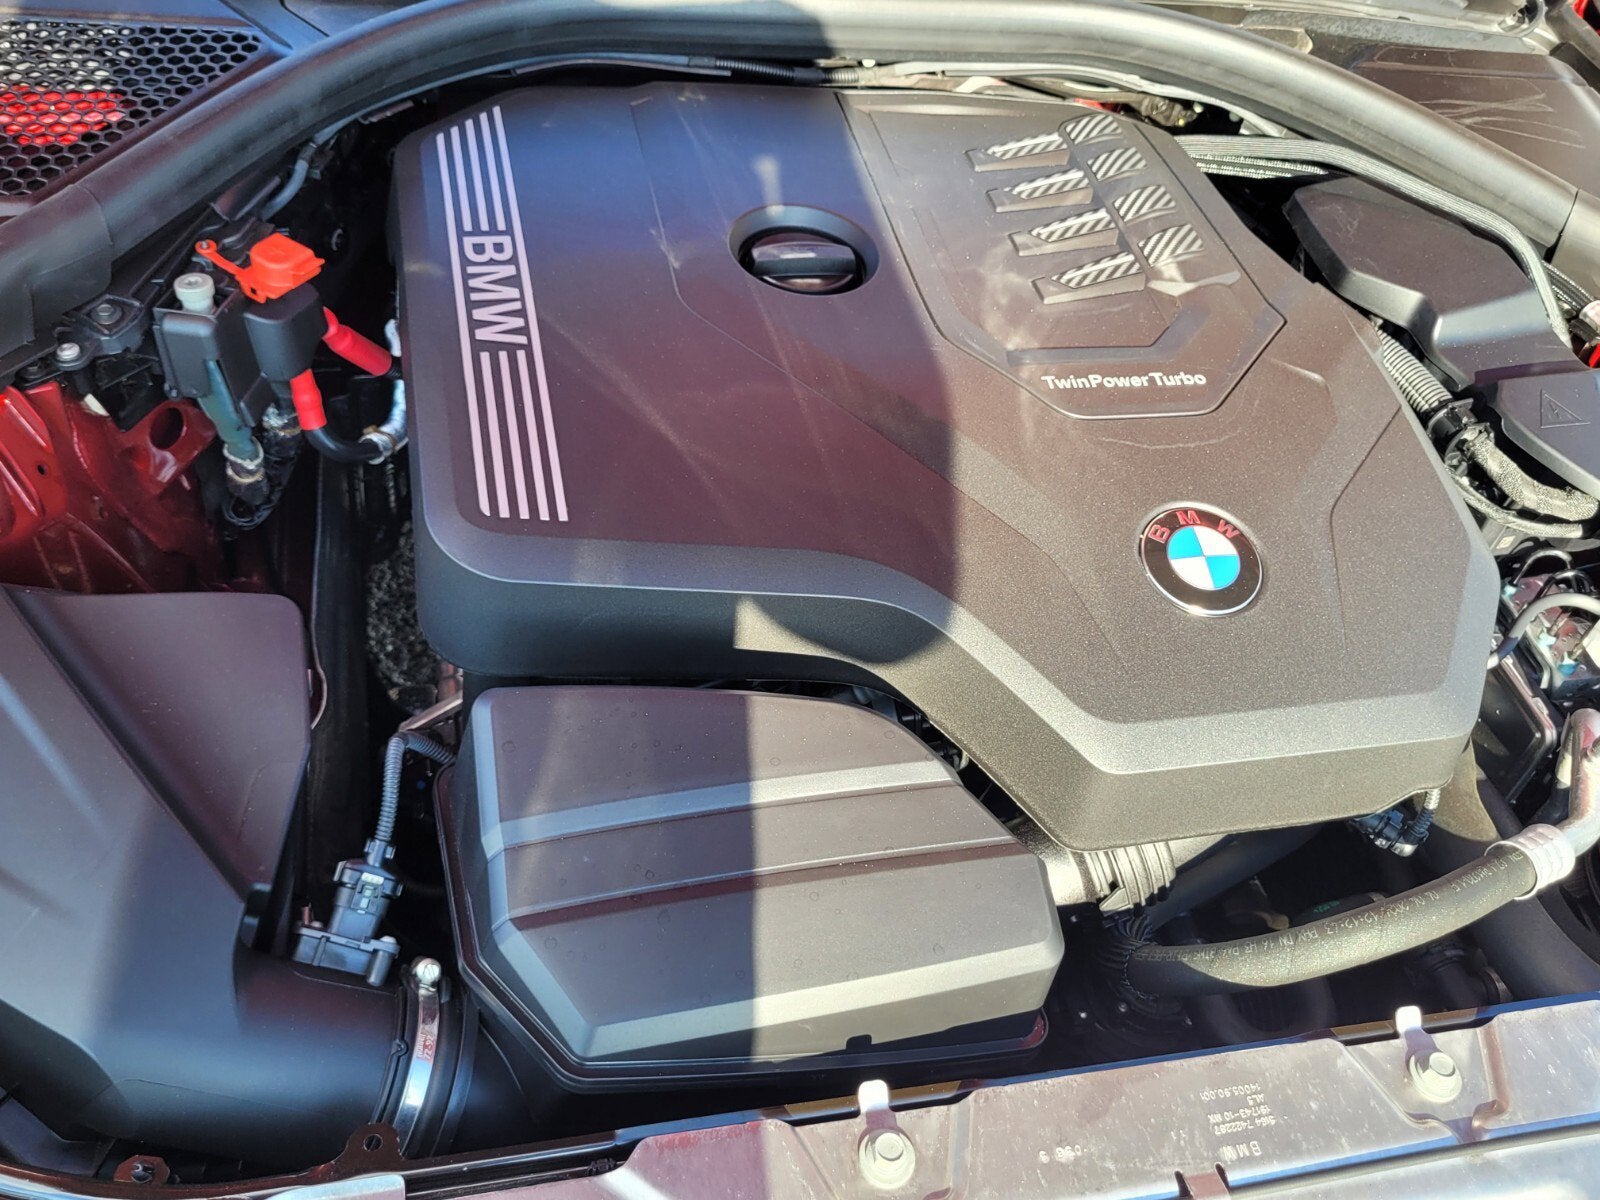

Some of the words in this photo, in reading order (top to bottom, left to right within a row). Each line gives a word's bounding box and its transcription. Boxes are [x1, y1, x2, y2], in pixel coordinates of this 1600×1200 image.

[462, 235, 529, 345] BMW
[1041, 374, 1150, 390] TwinPower
[1149, 372, 1207, 386] Turbo
[1148, 510, 1240, 544] BMW
[1223, 1104, 1271, 1121] 191743-10
[1221, 1141, 1262, 1161] BMW
